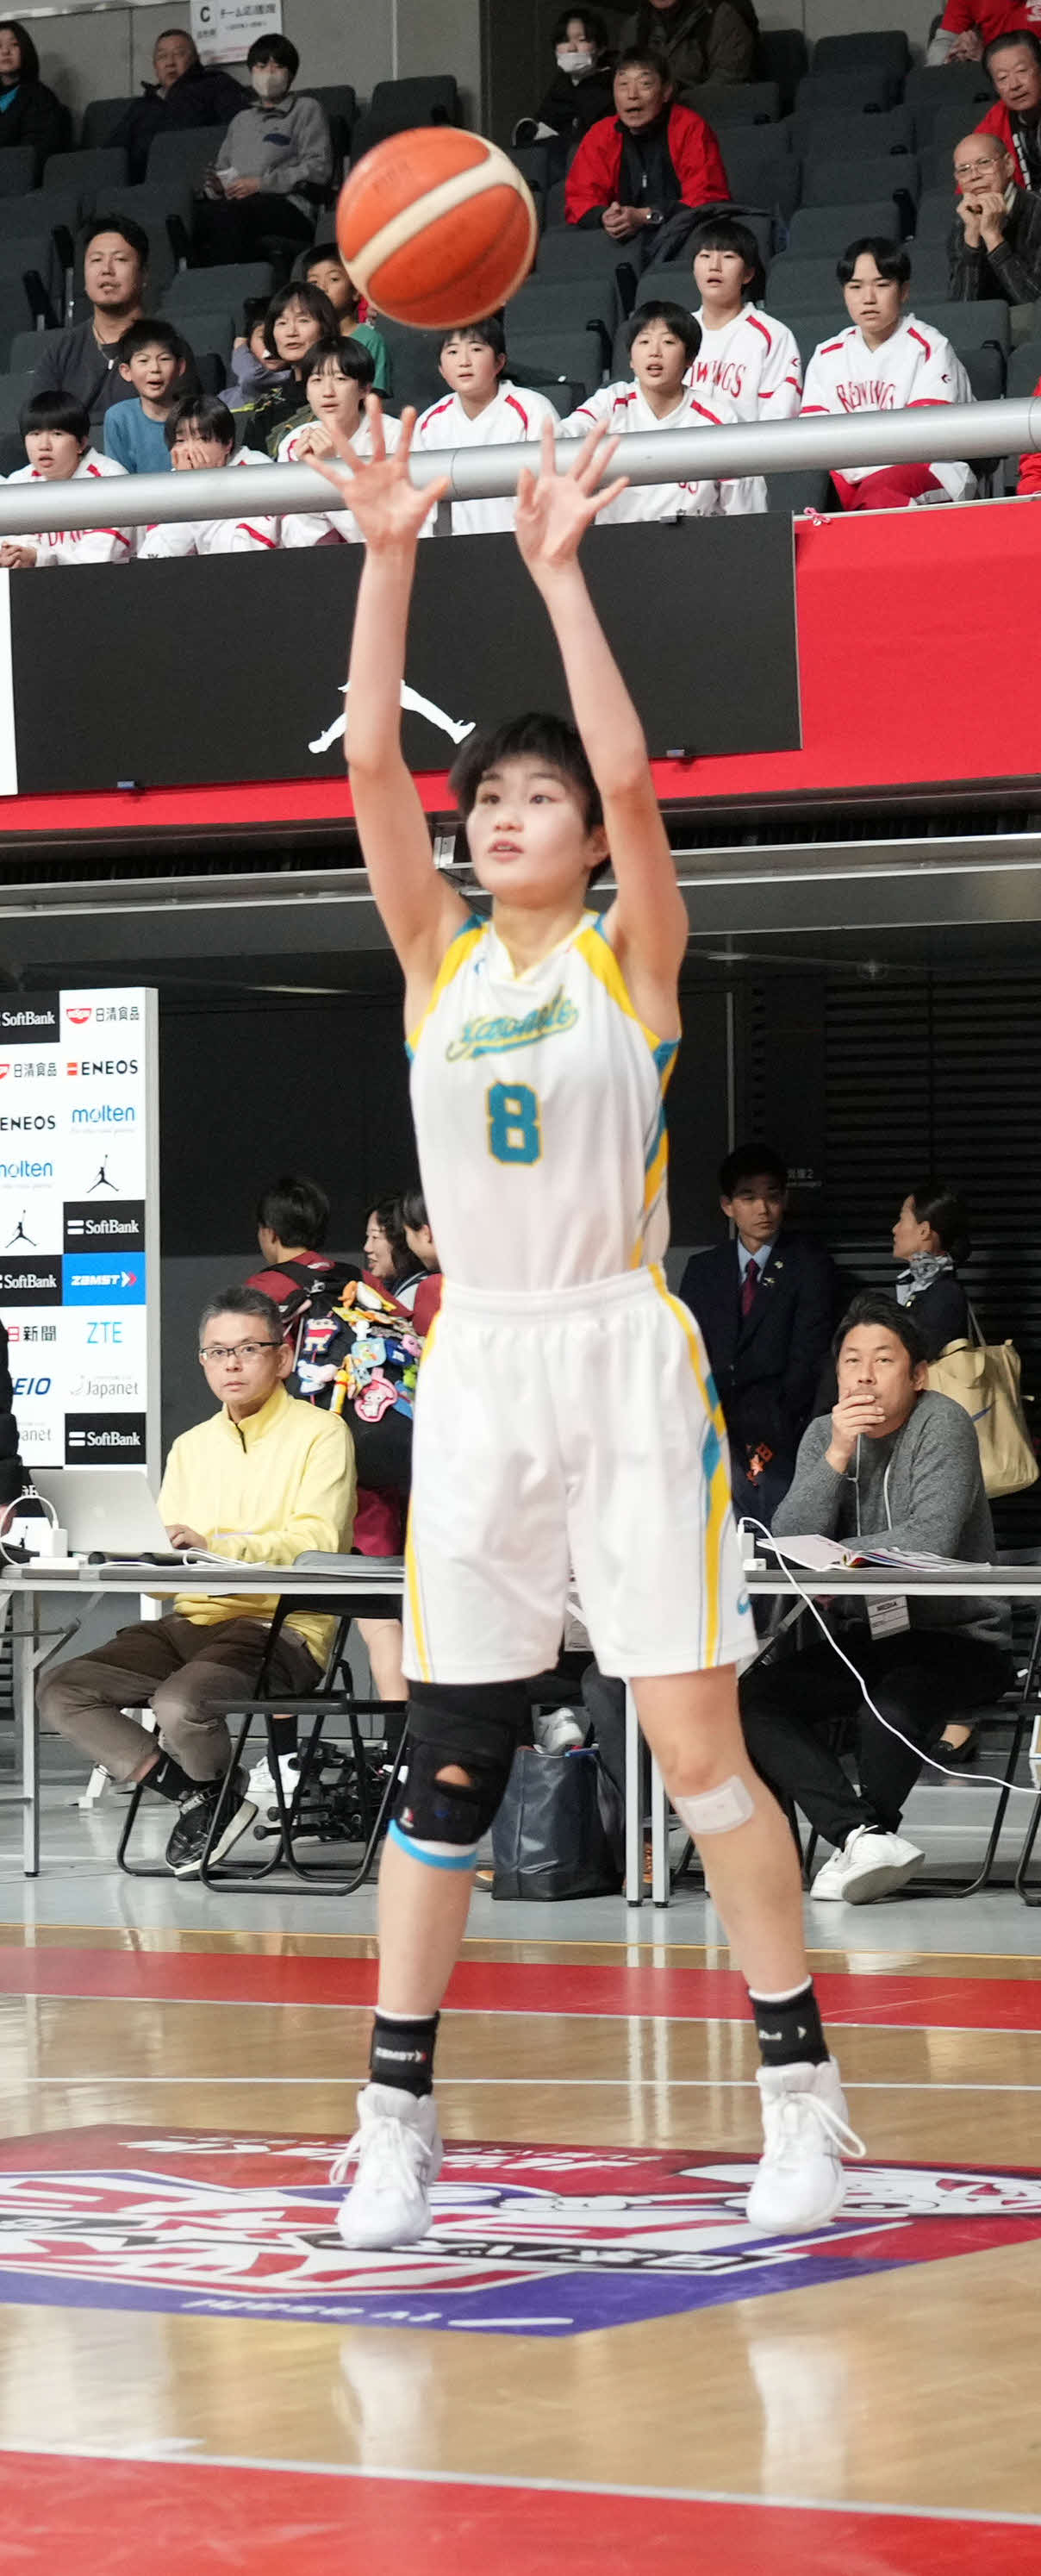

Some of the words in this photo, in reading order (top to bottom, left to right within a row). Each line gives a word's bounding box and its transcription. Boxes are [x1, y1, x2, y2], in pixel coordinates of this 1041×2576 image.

[200, 7, 210, 22] C
[2, 1011, 55, 1027] SoftBank
[96, 1006, 140, 1022] 日清食品
[14, 1062, 57, 1078] 日清食品
[81, 1060, 138, 1075] ENEOS
[72, 1105, 134, 1122] molten
[0, 1116, 55, 1131] ENEOS
[485, 1079, 543, 1166] 8
[85, 1220, 139, 1235] SoftBank
[4, 1274, 57, 1289] SoftBank
[87, 1322, 122, 1343] ZTE
[12, 1378, 51, 1395] EIO
[86, 1380, 138, 1398] Japanet
[21, 1429, 51, 1441] anet
[87, 1431, 140, 1447] SoftBank
